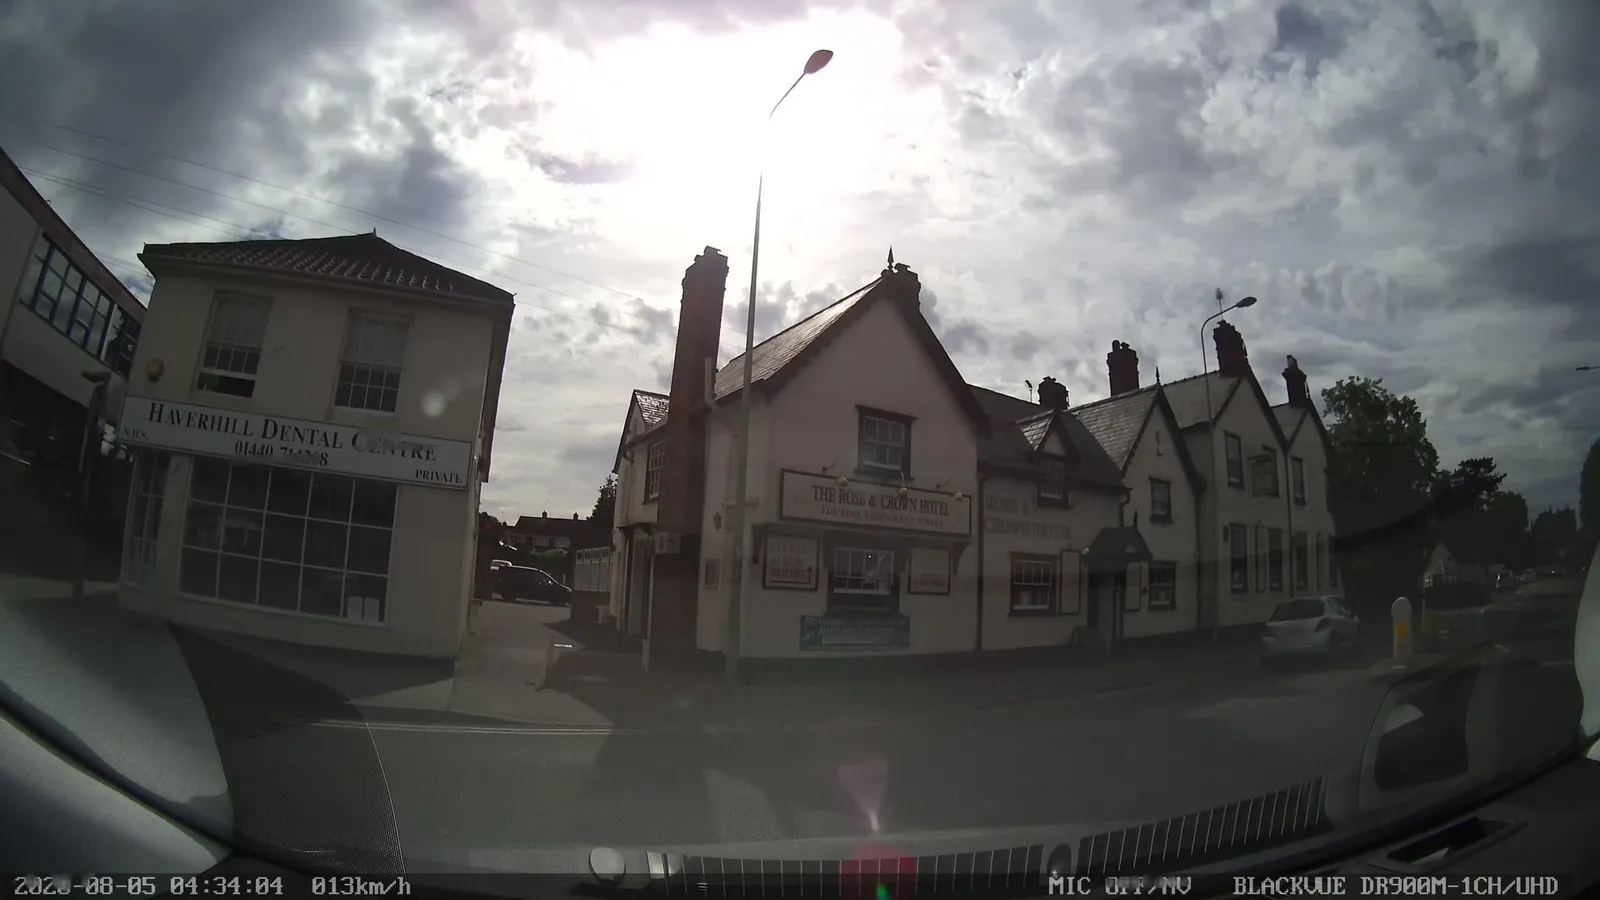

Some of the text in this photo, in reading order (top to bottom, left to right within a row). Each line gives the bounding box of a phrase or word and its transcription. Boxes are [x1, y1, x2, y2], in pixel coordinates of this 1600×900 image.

[148, 402, 253, 437] HAVERHILL
[261, 419, 343, 449] DENTAL
[235, 440, 274, 456] 01440
[415, 469, 462, 485] PRIVATE
[812, 484, 950, 516] THE ROSE & CROWN HOTEL
